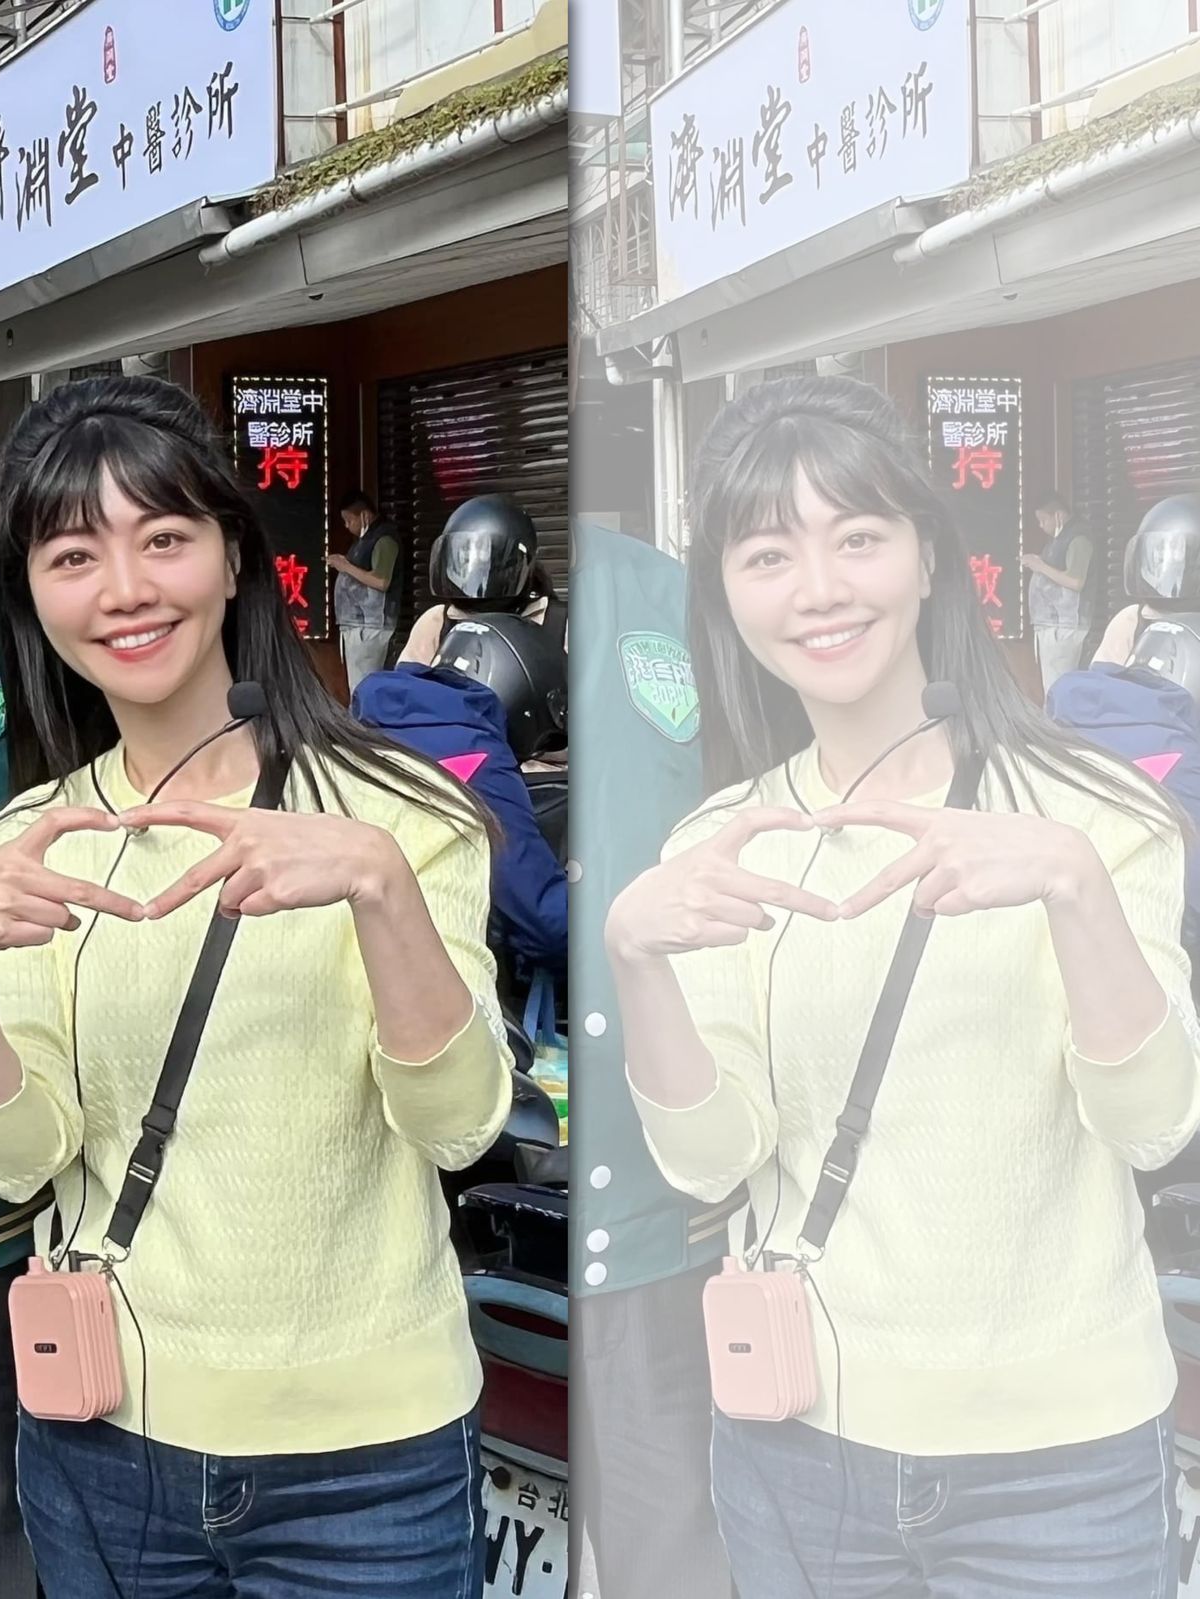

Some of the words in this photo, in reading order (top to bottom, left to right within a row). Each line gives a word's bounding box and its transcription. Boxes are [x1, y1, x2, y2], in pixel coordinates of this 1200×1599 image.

[236, 389, 324, 415] 濟淵堂中
[931, 389, 1018, 415] 濟淵堂中
[247, 421, 314, 448] 醫診所
[942, 421, 1008, 448] 醫診所
